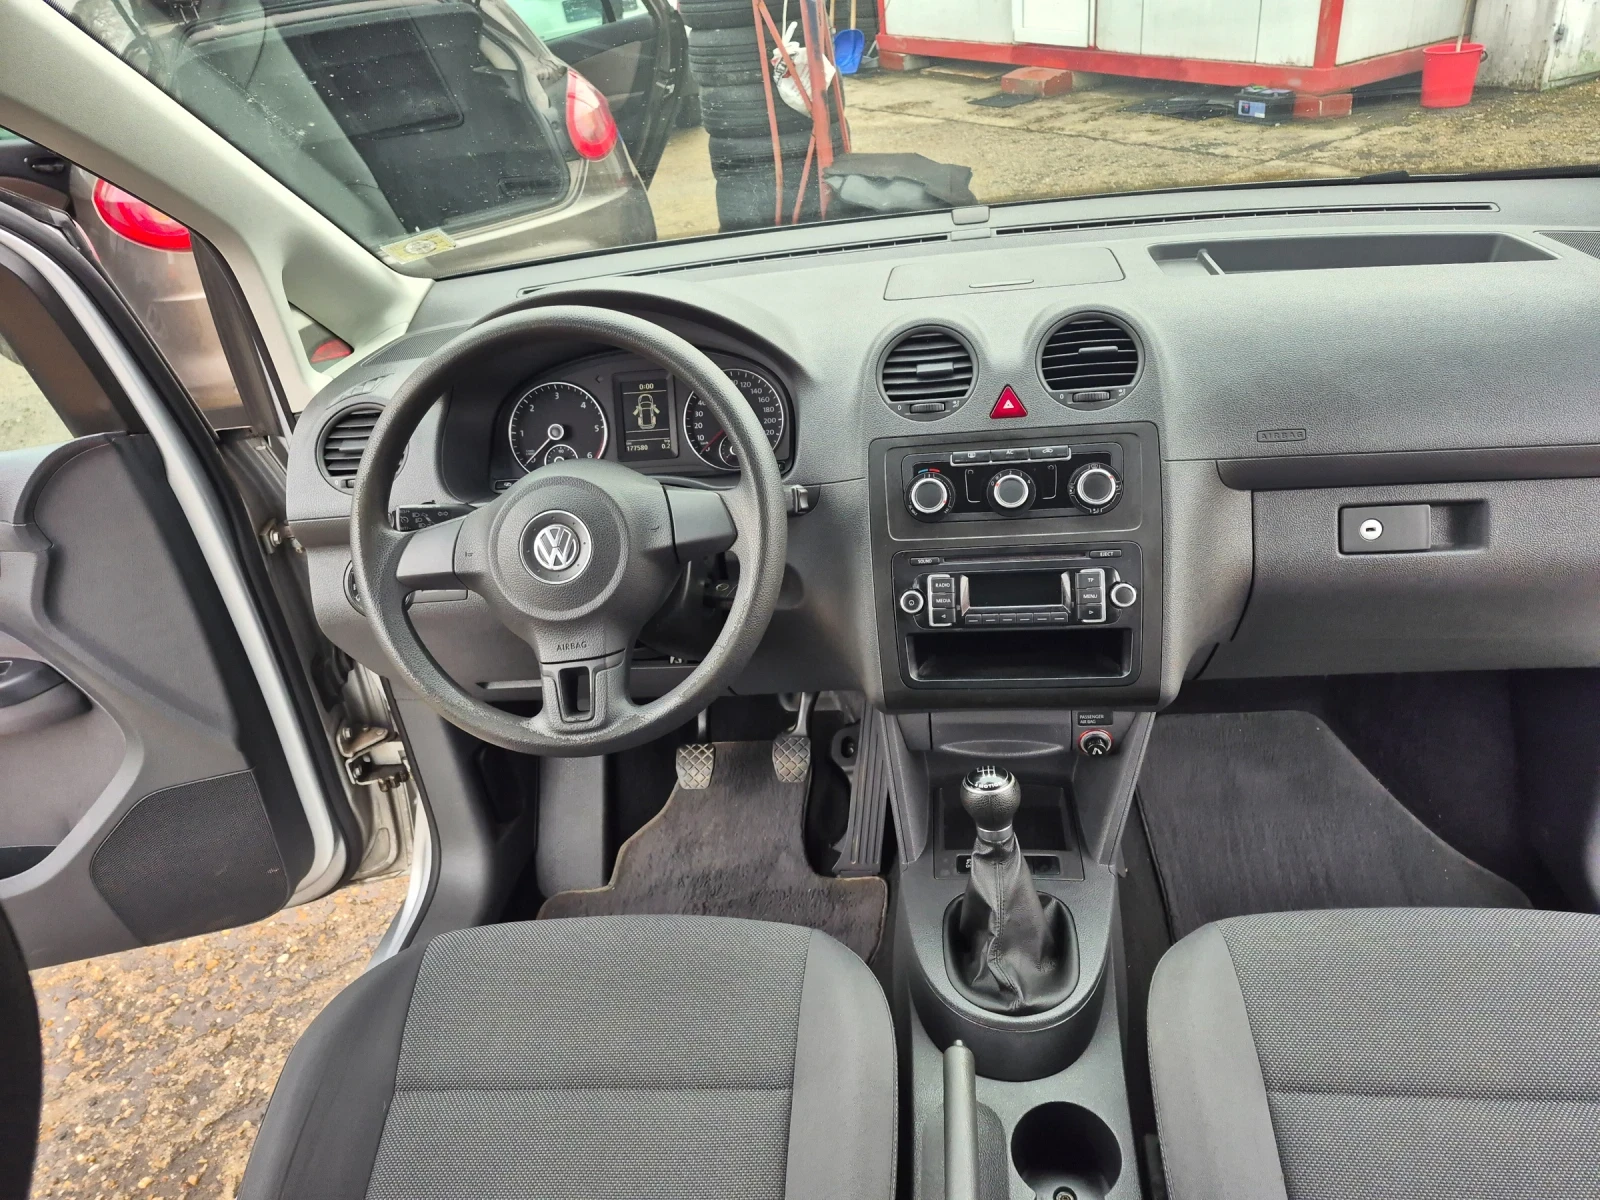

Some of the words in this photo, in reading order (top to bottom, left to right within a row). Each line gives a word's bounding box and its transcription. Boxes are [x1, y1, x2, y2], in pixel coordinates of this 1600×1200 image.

[638, 382, 655, 390] 0:00
[554, 392, 560, 400] 3
[529, 404, 535, 412] 2
[580, 401, 587, 409] 4
[694, 410, 704, 418] 30
[594, 424, 600, 432] 5
[1261, 431, 1303, 440] AIRBAG
[556, 640, 588, 652] AIRBAG
